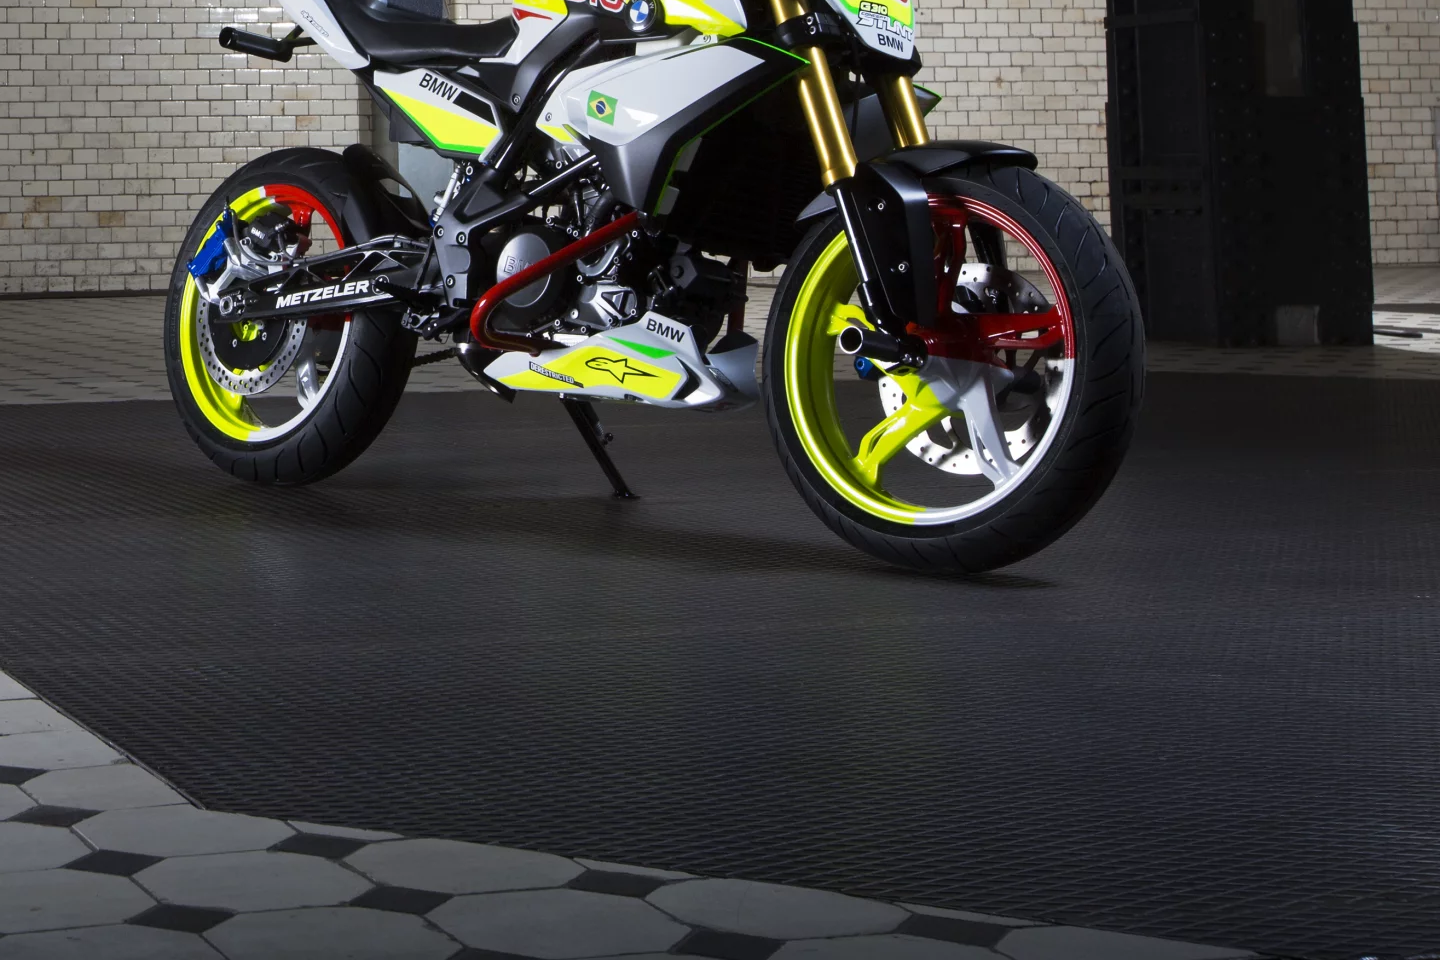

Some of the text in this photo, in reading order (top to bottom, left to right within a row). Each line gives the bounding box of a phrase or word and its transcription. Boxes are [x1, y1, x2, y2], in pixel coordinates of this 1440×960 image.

[860, 1, 888, 15] G310
[856, 11, 914, 41] STUNT
[877, 33, 904, 53] BMW
[419, 72, 458, 101] BMW
[251, 226, 266, 240] BMW
[275, 279, 370, 309] METZELER
[646, 318, 686, 343] BMW
[530, 362, 574, 383] DERESTRICTED
